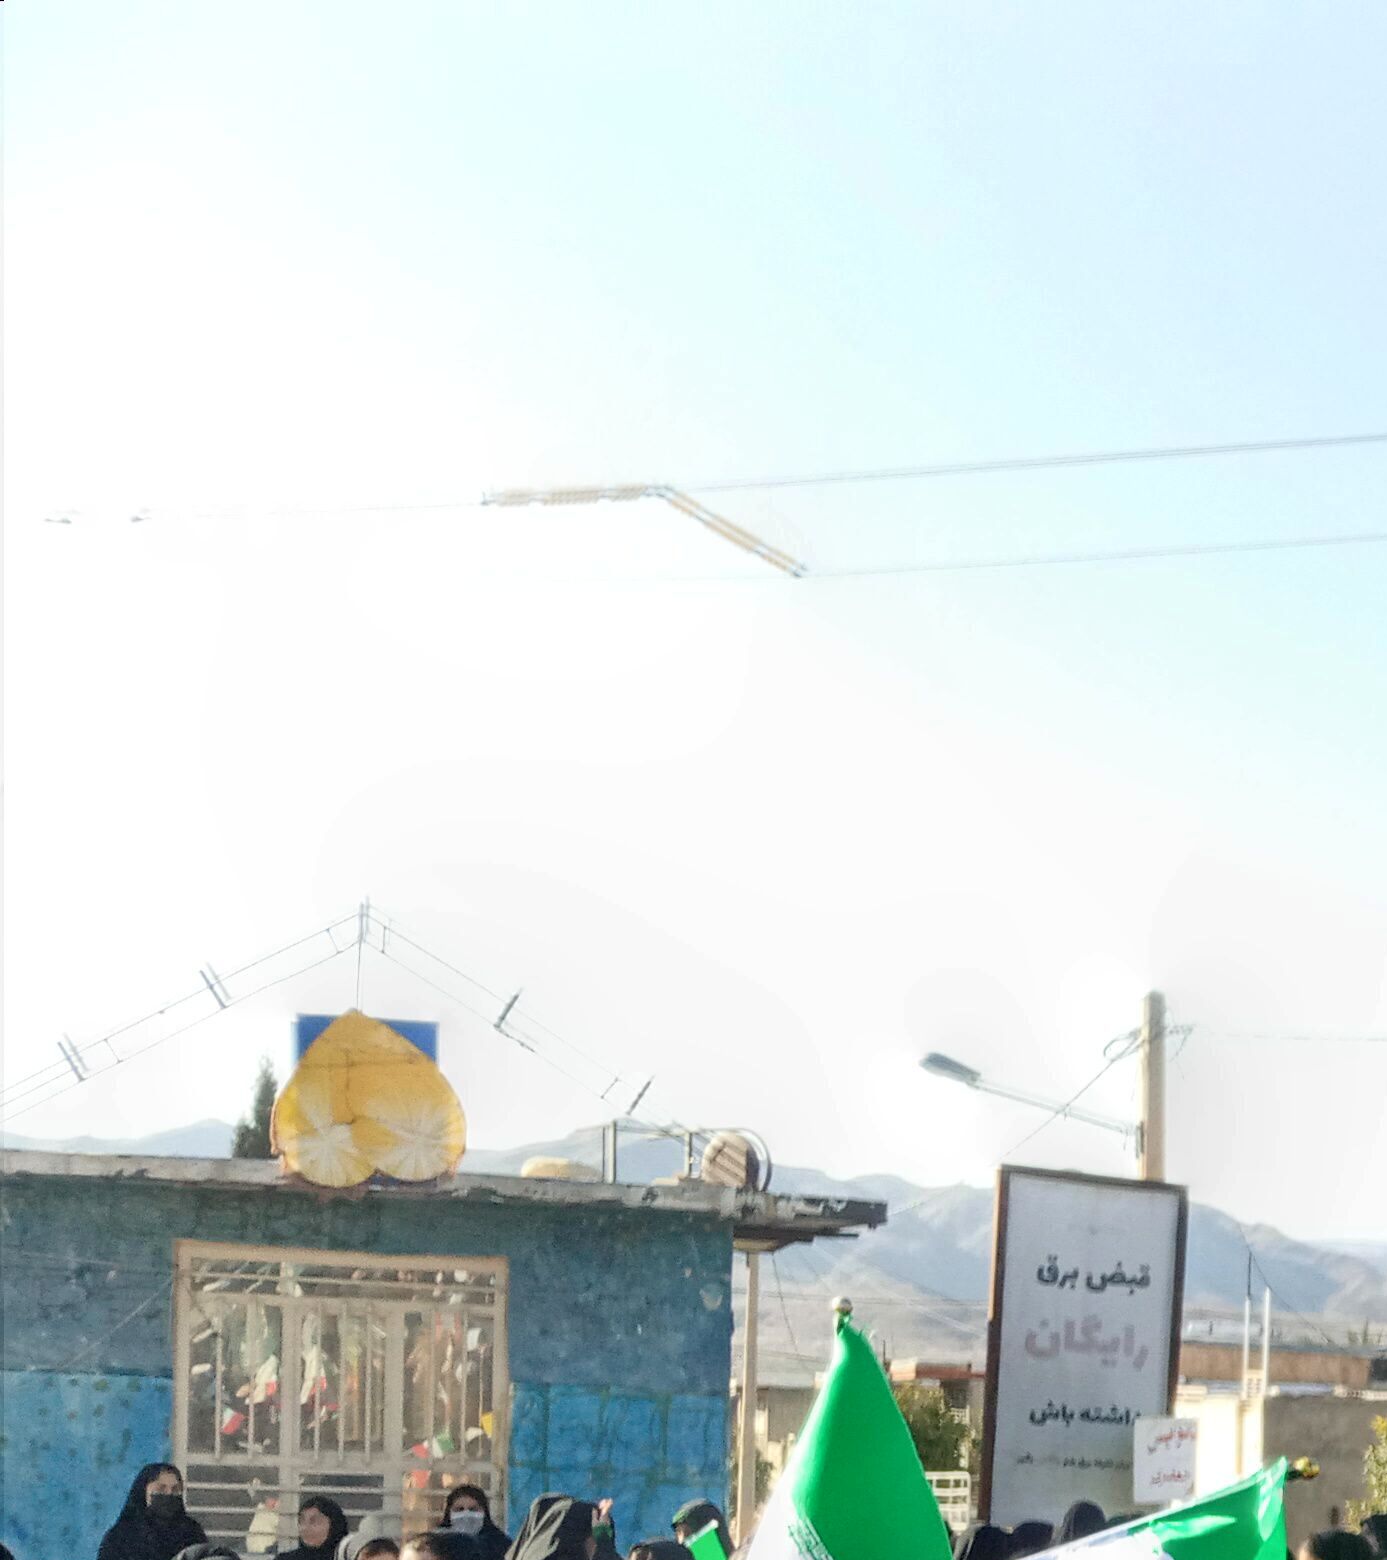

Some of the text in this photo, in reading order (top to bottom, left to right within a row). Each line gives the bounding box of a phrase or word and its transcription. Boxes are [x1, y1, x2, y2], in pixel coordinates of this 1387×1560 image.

[1037, 1255, 1150, 1294] قبض برق
[1024, 1315, 1149, 1371] رایگان
